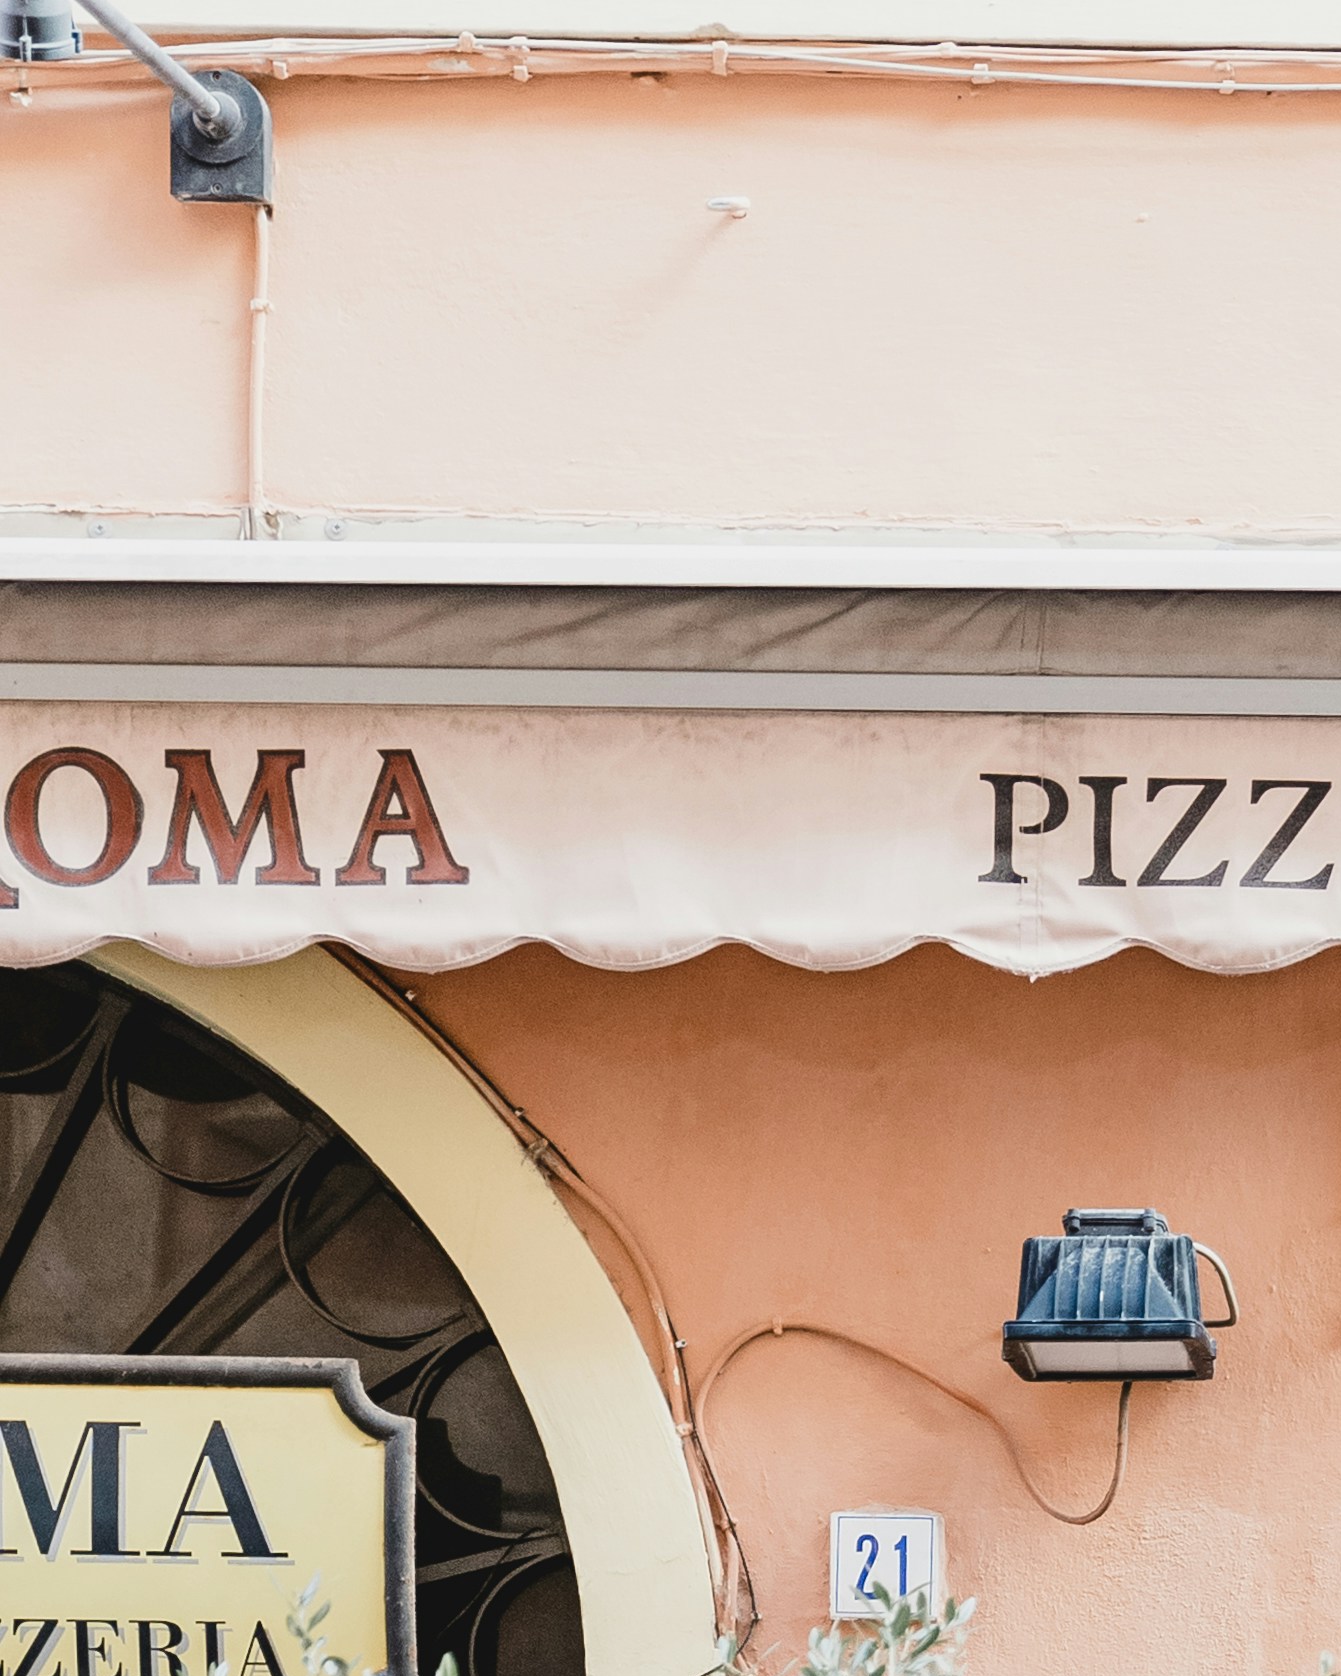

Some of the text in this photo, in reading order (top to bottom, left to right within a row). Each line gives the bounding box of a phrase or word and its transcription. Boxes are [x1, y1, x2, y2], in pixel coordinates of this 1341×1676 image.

[0, 746, 470, 909] OMA
[0, 1419, 291, 1560] MA
[854, 1533, 908, 1600] 21
